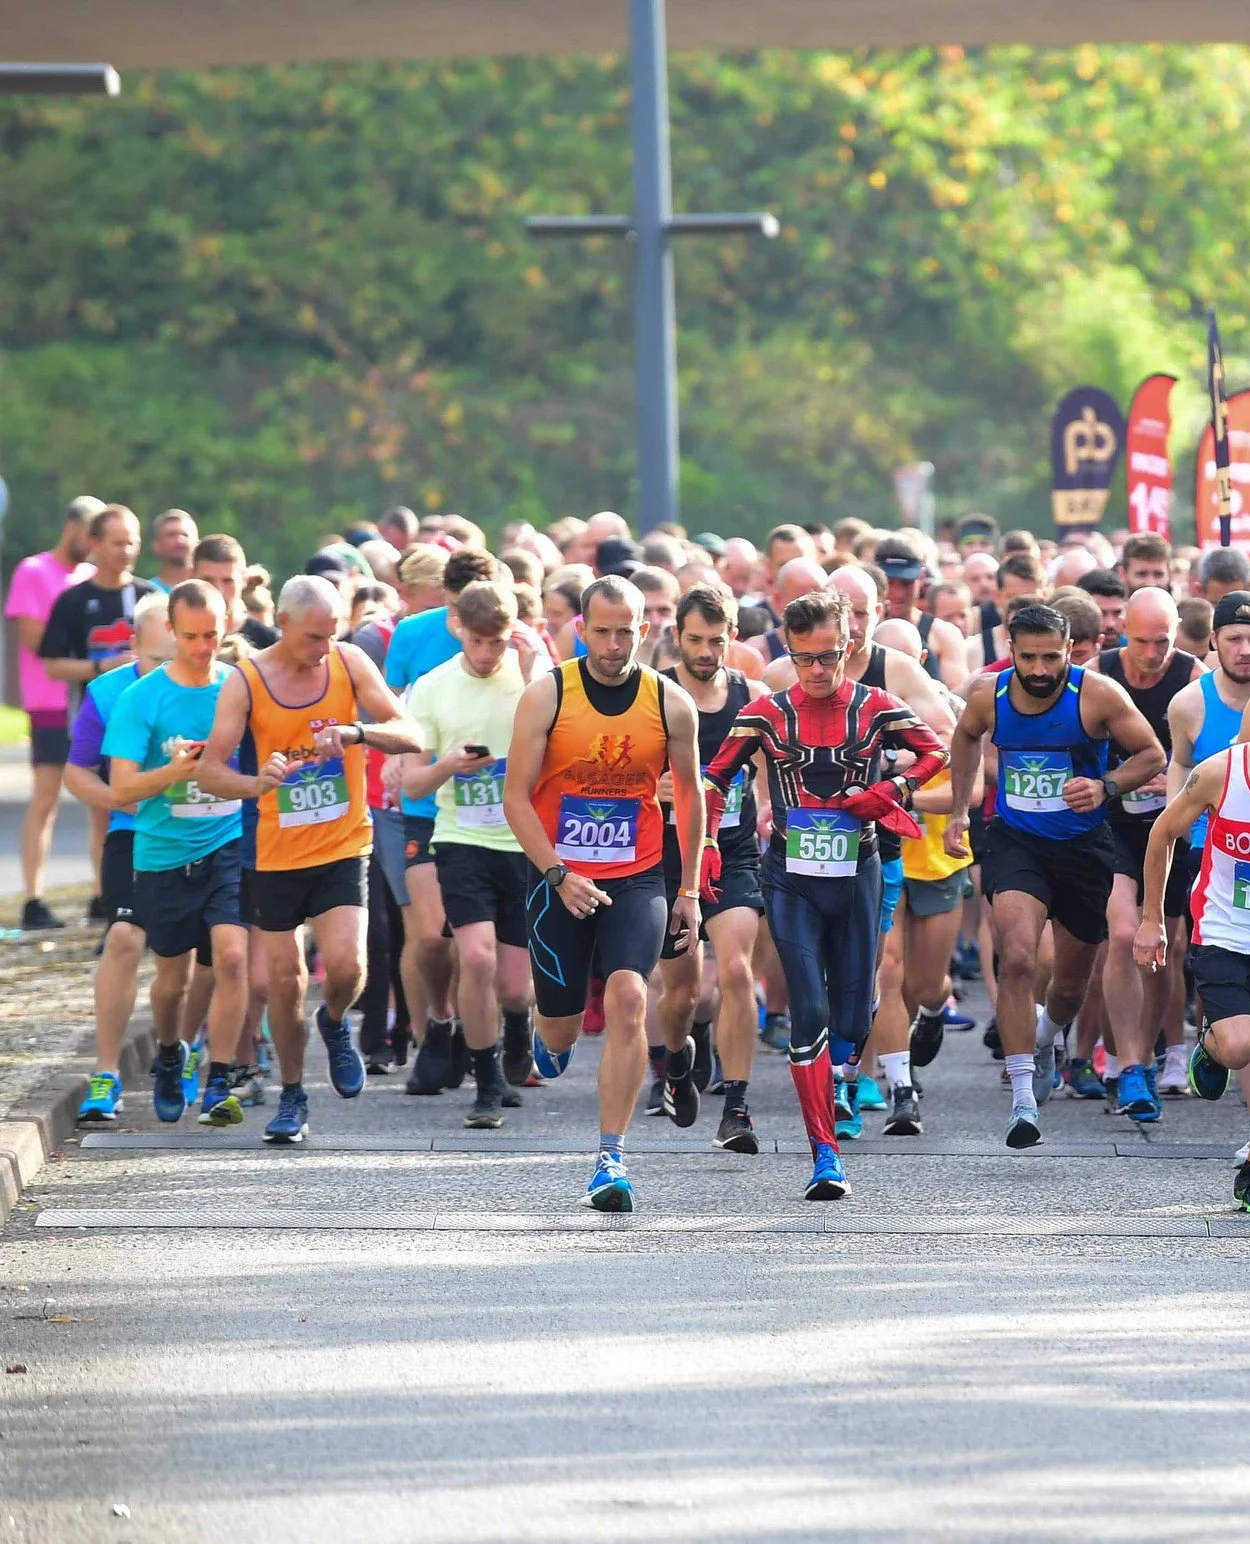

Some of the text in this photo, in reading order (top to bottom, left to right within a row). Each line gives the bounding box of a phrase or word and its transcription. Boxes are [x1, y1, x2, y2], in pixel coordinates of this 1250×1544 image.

[290, 780, 337, 811] 903
[581, 787, 628, 797] RUNNERS
[1011, 772, 1068, 798] 1267
[563, 819, 631, 847] 2004
[800, 833, 848, 861] 550
